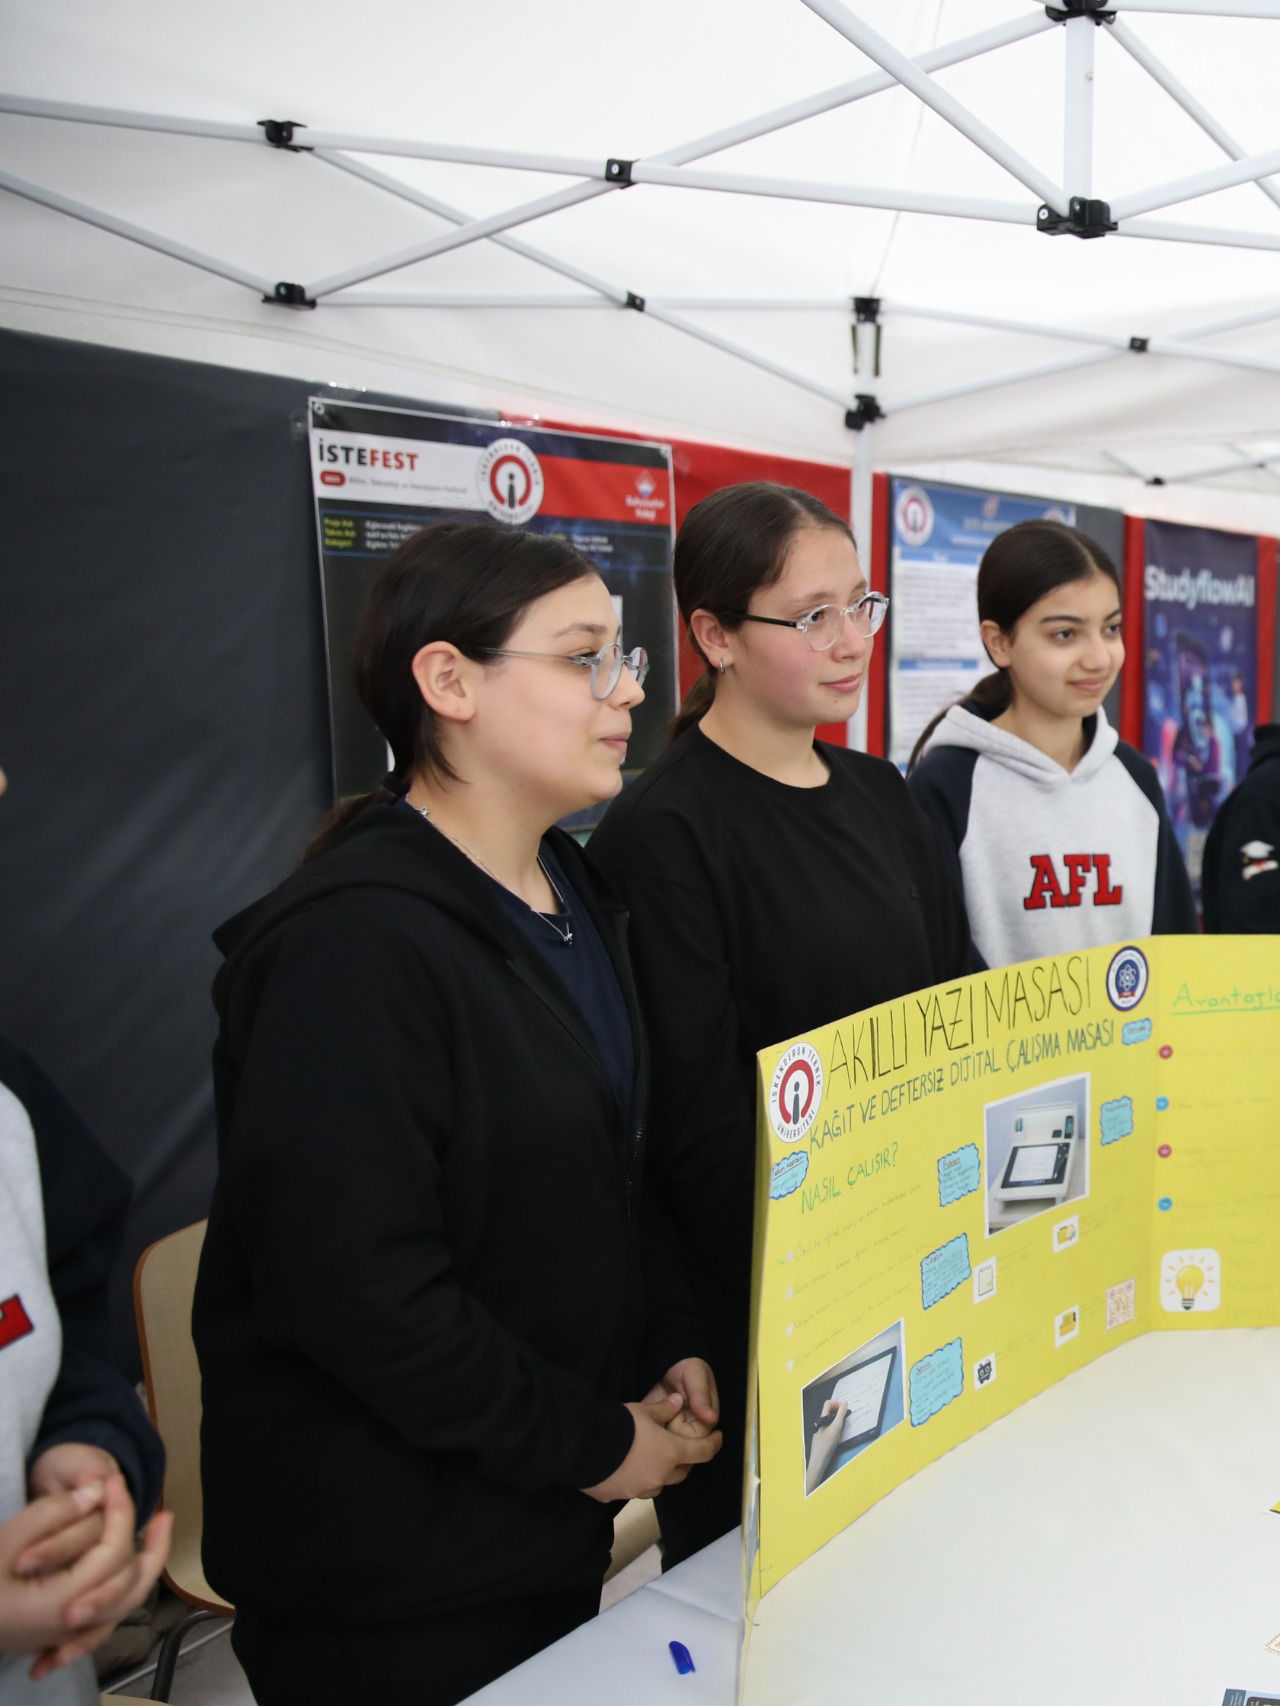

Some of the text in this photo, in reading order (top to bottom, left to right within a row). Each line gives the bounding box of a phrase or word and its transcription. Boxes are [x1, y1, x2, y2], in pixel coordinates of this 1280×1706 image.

[318, 437, 418, 472] İSTEFEST
[1024, 854, 1123, 911] AFL
[826, 1001, 909, 1101] AKILLI
[916, 983, 975, 1058] YAZI
[984, 955, 1092, 1039] MASASI
[809, 1104, 856, 1156] KAĞIT
[859, 1094, 877, 1124] VE
[1006, 1032, 1062, 1073] ÇALIŞMA
[1066, 1019, 1115, 1055] MASASI
[801, 1175, 842, 1215] NASIL
